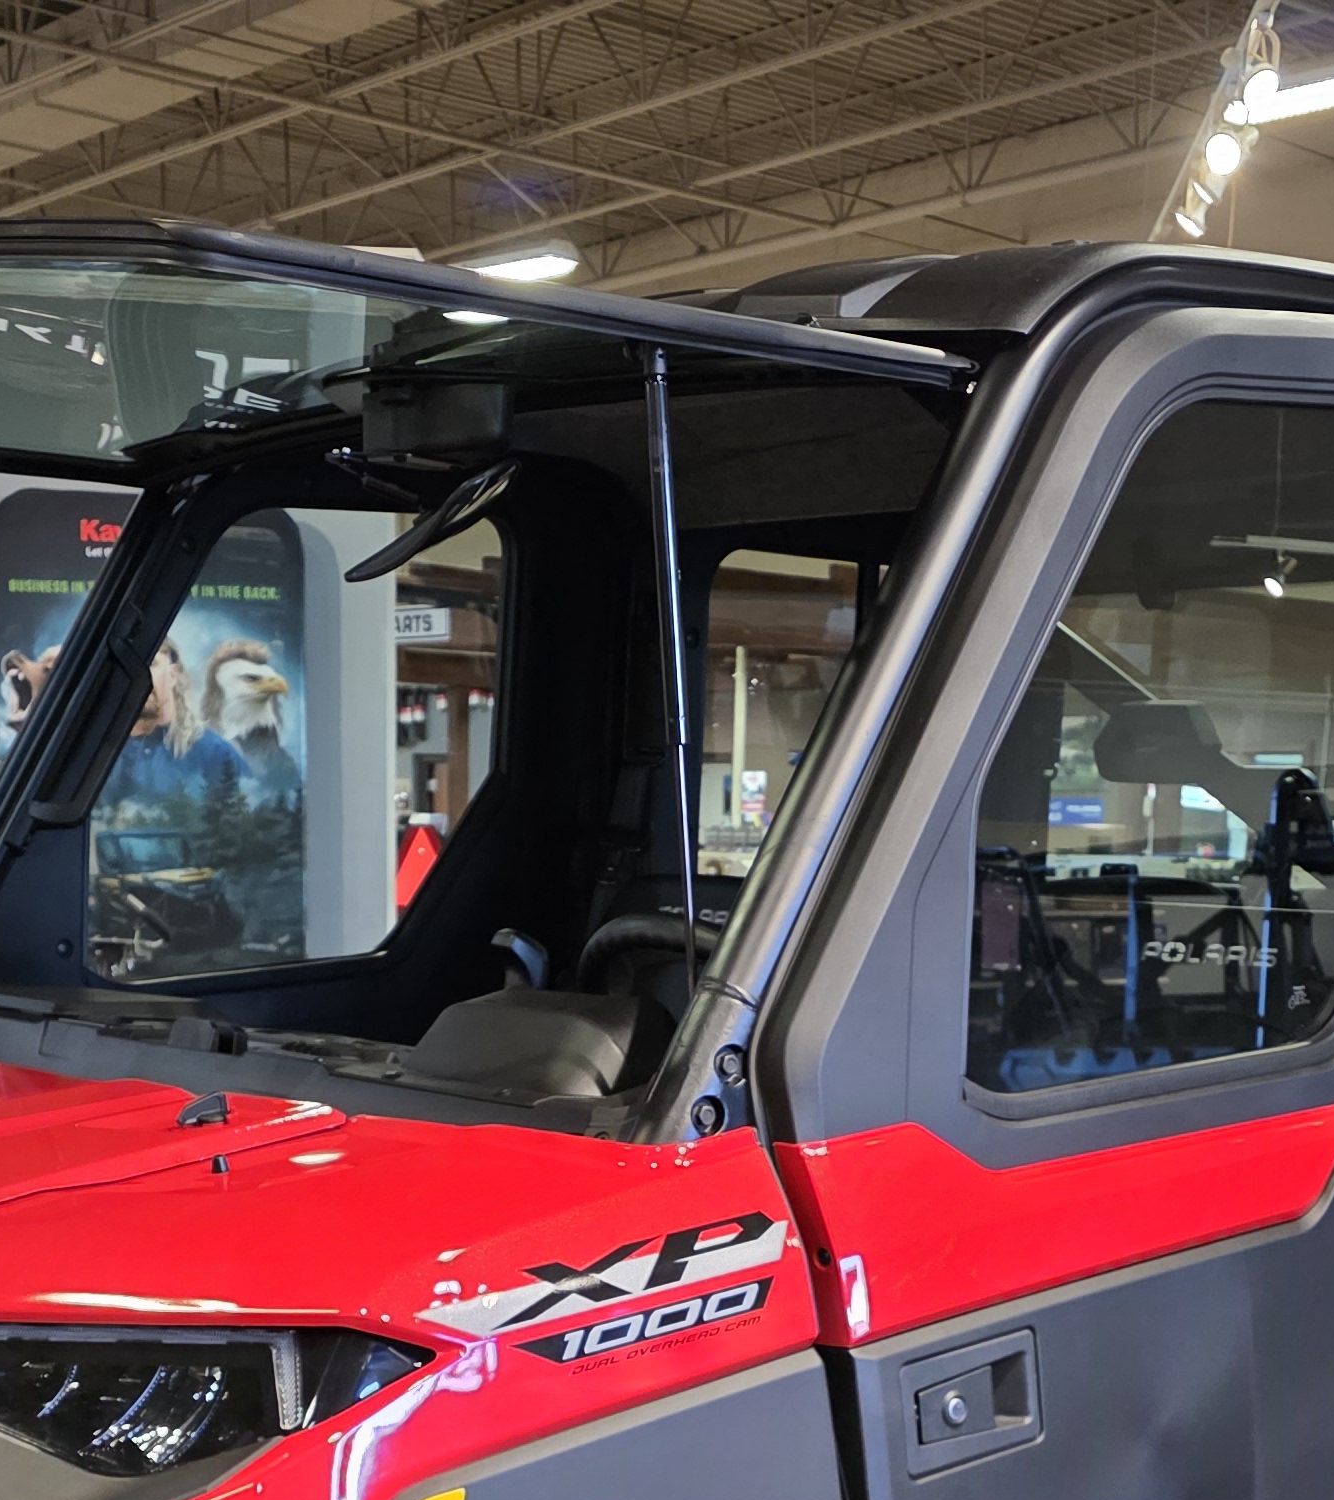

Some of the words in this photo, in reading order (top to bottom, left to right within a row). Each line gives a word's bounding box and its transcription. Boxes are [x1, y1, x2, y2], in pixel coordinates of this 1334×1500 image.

[200, 585, 216, 598] IN
[217, 585, 241, 599] THE
[1140, 940, 1280, 968] POLARIS
[489, 1209, 776, 1332] XP
[561, 1282, 760, 1361] 1000
[571, 1354, 621, 1376] DUAL
[626, 1326, 721, 1360] OVERHEAD
[724, 1314, 763, 1334] CAM
